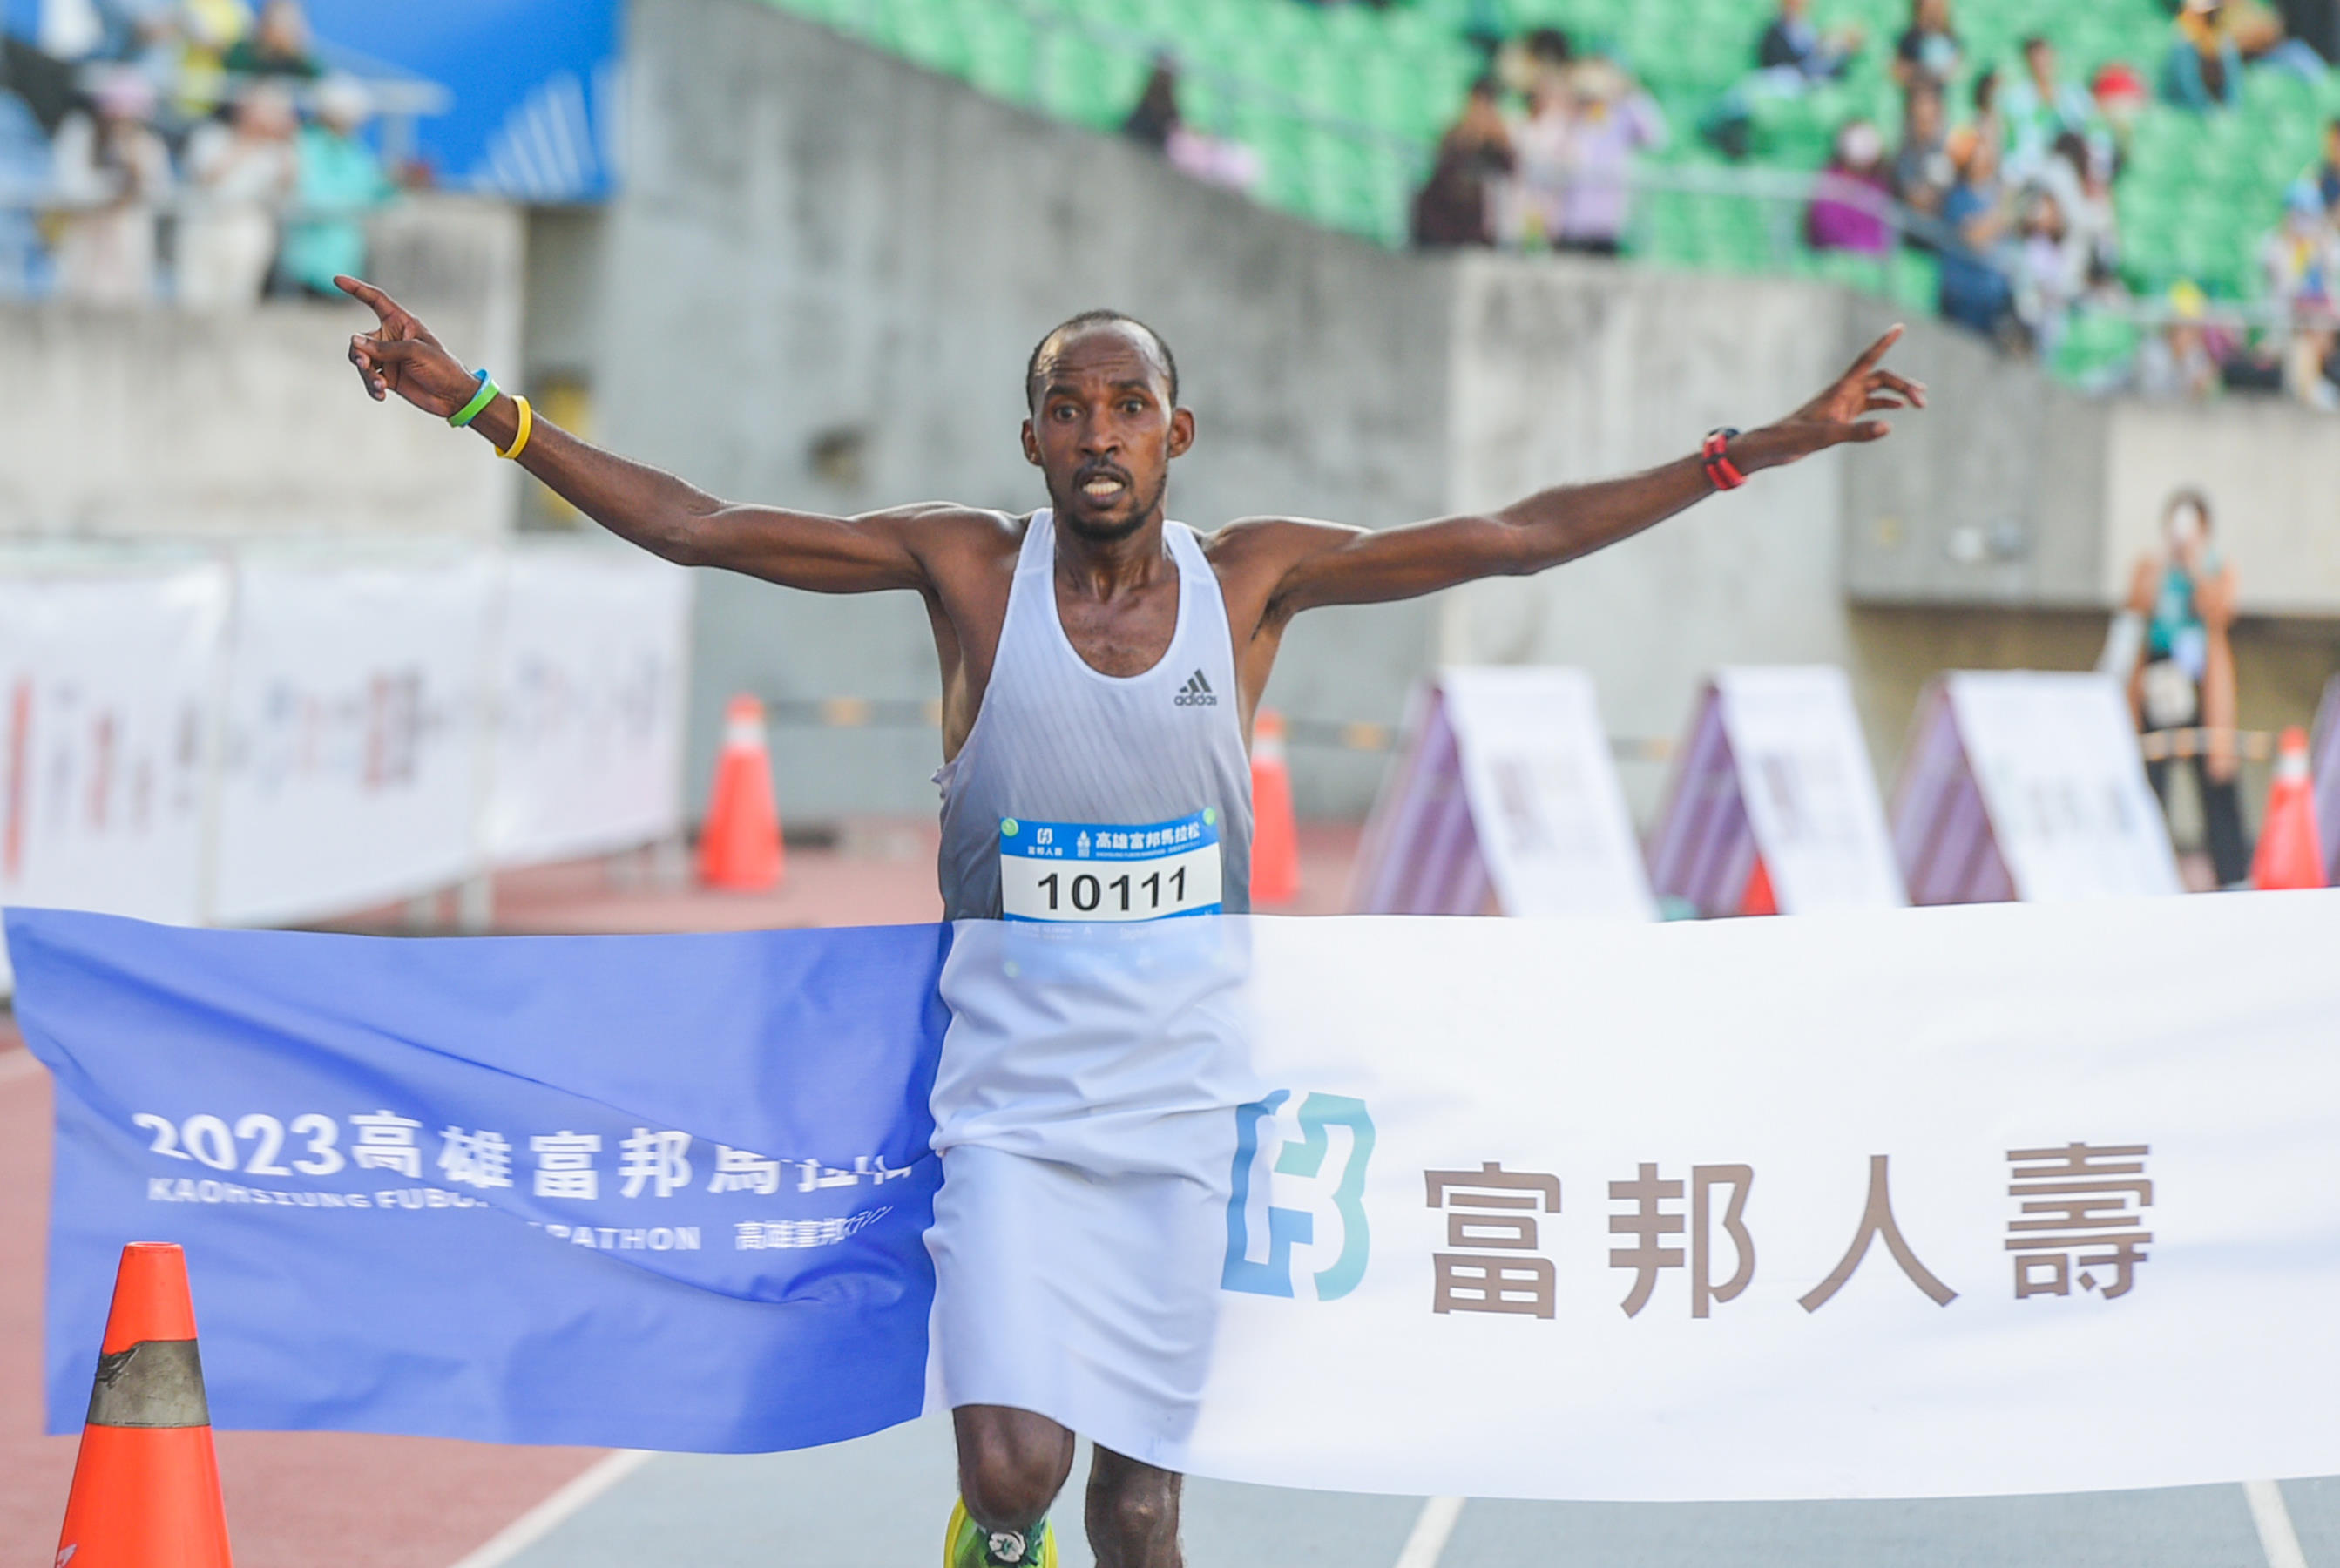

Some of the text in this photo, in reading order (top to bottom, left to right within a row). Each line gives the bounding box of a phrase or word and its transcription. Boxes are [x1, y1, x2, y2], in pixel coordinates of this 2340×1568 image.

[1095, 821, 1200, 850] 高雄富邦馬拉松
[1038, 865, 1186, 911] 10111
[1424, 1142, 2153, 1320] 富邦人壽
